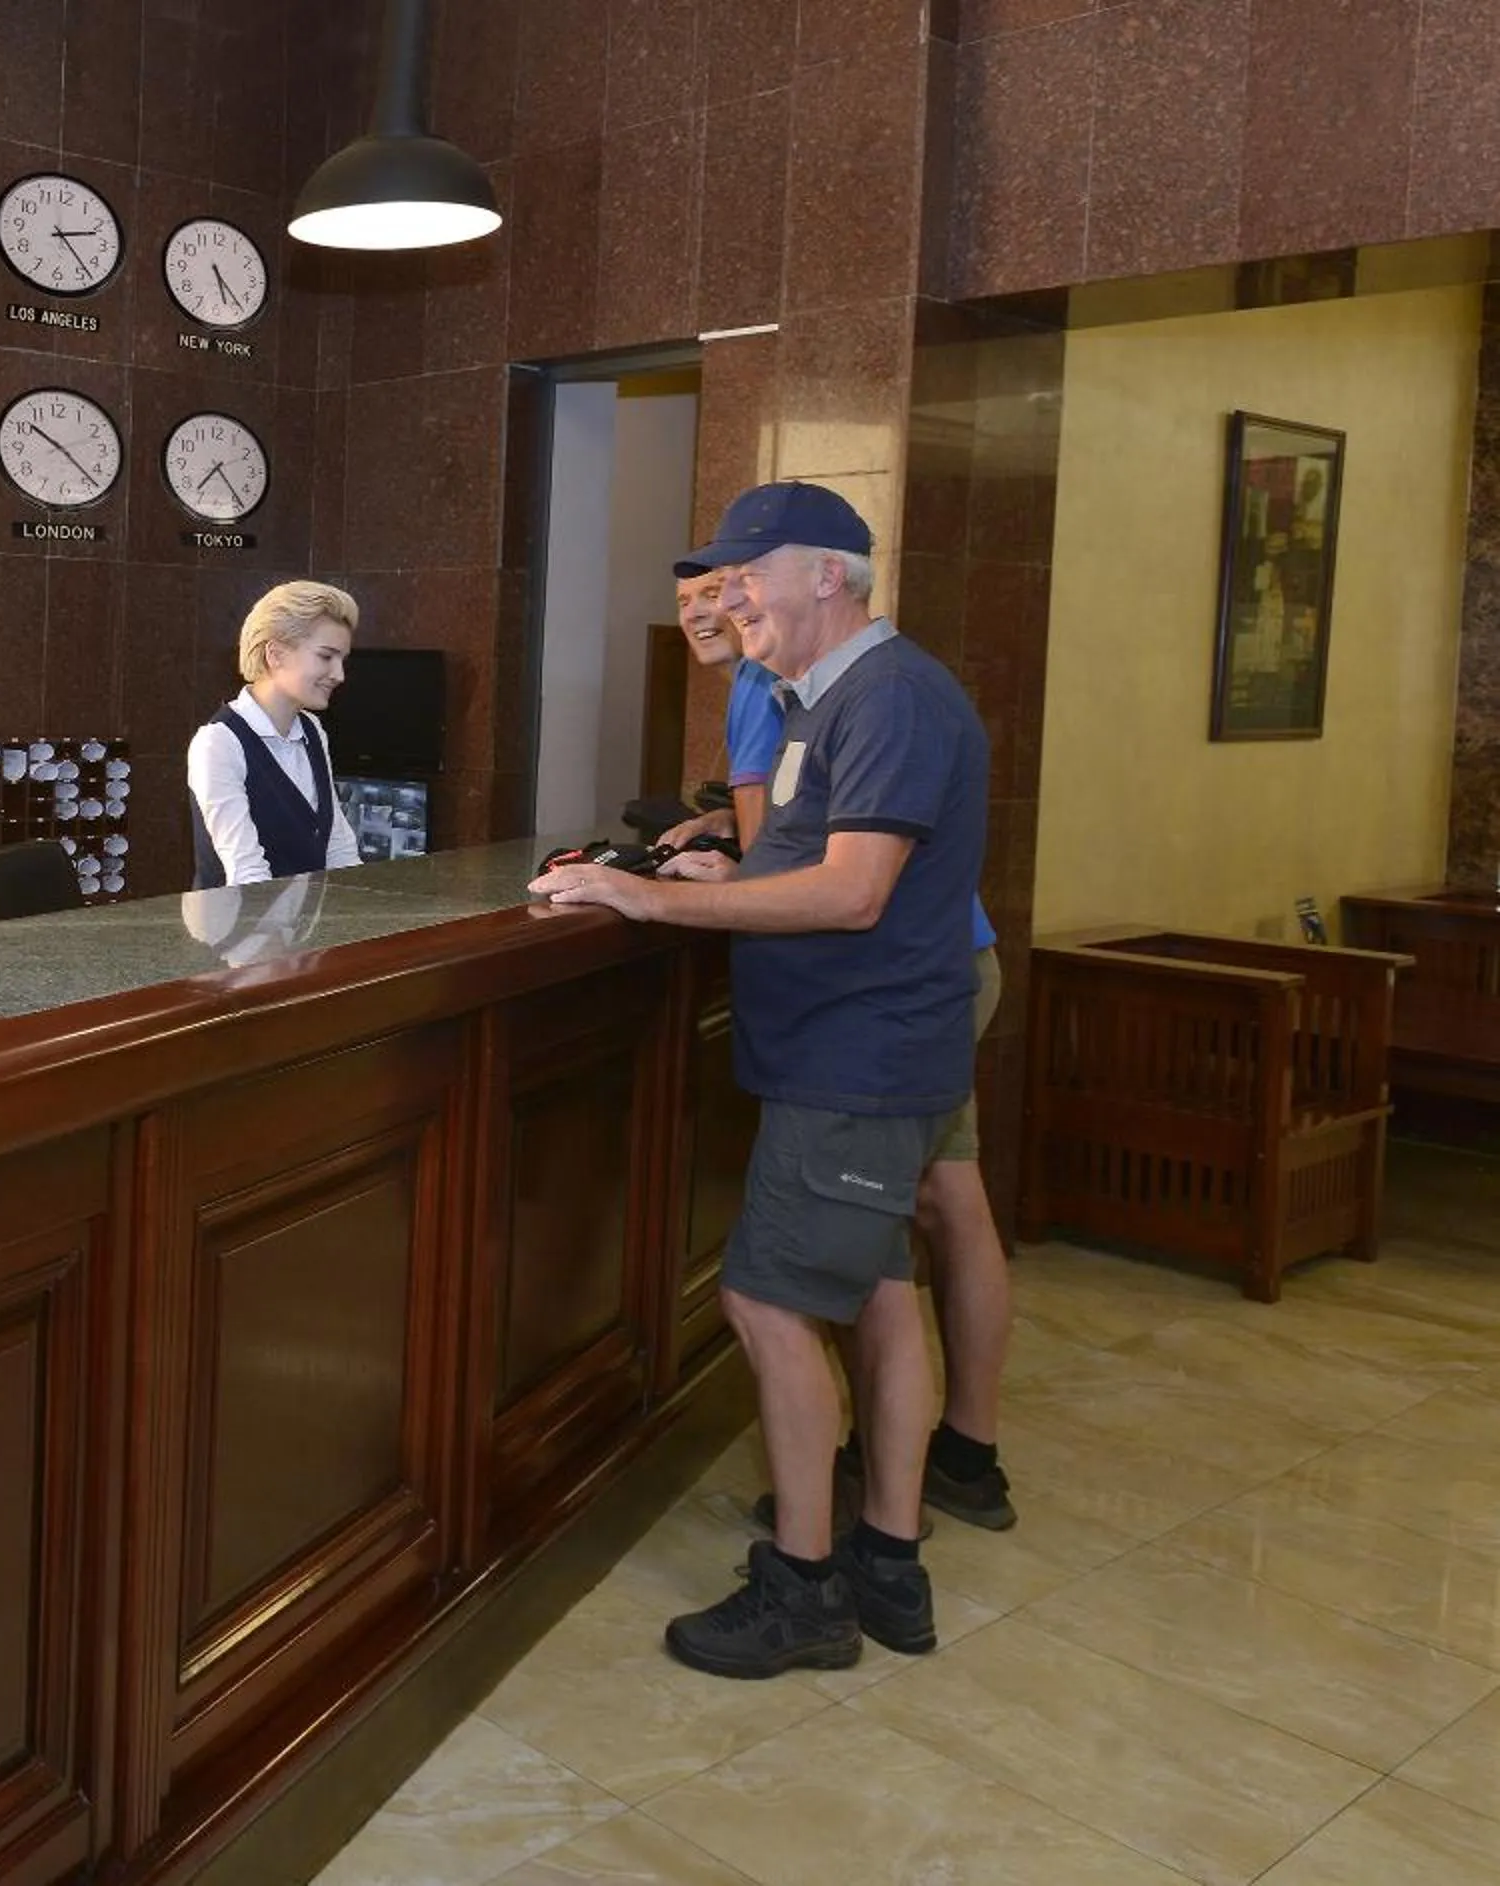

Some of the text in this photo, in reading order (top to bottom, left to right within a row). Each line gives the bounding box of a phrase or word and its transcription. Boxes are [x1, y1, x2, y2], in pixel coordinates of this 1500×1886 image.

[39, 190, 51, 204] 11
[59, 189, 76, 206] 12
[21, 200, 37, 215] 10
[13, 218, 25, 232] 9
[17, 239, 29, 252] 8
[100, 239, 109, 252] 3
[197, 233, 207, 247] 11
[213, 232, 226, 246] 12
[183, 242, 197, 256] 10
[34, 257, 43, 270] 7
[177, 260, 187, 272] 9
[52, 267, 63, 281] 6
[10, 305, 97, 331] LOS ANGELES
[179, 334, 252, 357] NEW YORK
[33, 407, 43, 421] 11
[51, 403, 67, 418] 12
[16, 421, 33, 436] 10
[90, 423, 101, 439] 2
[195, 428, 205, 443] 11
[211, 426, 224, 441] 12
[11, 441, 25, 456] 9
[97, 442, 108, 458] 3
[181, 439, 195, 452] 10
[20, 461, 33, 476] 8
[23, 524, 96, 541] LONDON
[194, 533, 243, 548] TOKYO
